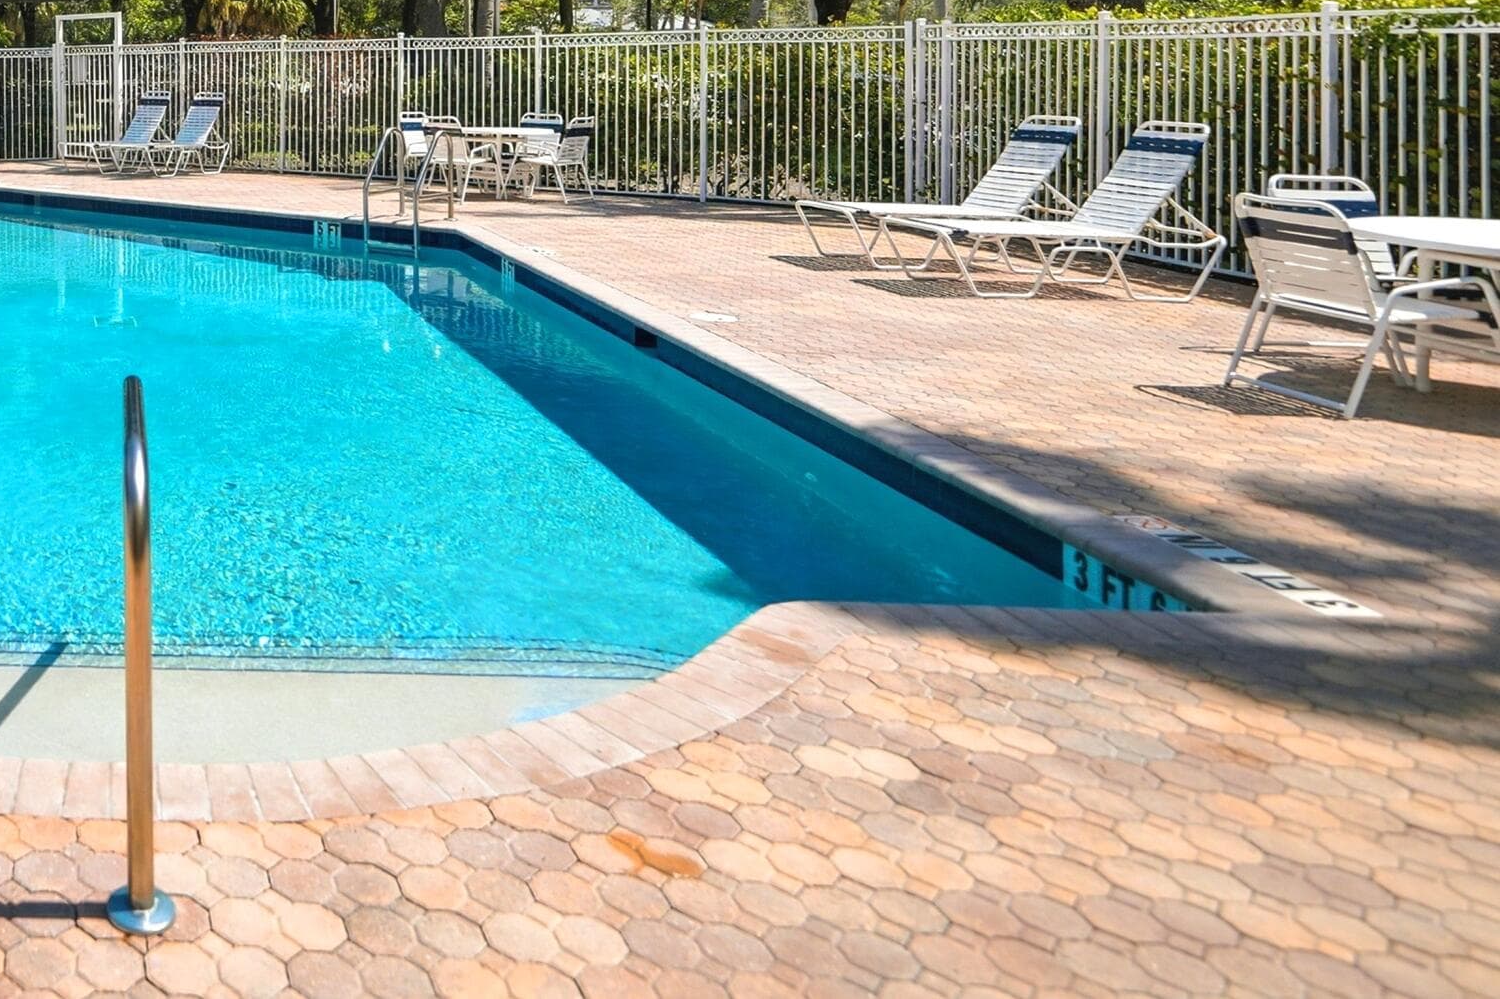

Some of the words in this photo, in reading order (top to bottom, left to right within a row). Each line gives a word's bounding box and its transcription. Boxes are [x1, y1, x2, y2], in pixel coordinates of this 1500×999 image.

[1073, 551, 1089, 592] 3
[1101, 564, 1136, 610] FT
[1239, 571, 1322, 592] FT
[1302, 599, 1358, 609] 3
